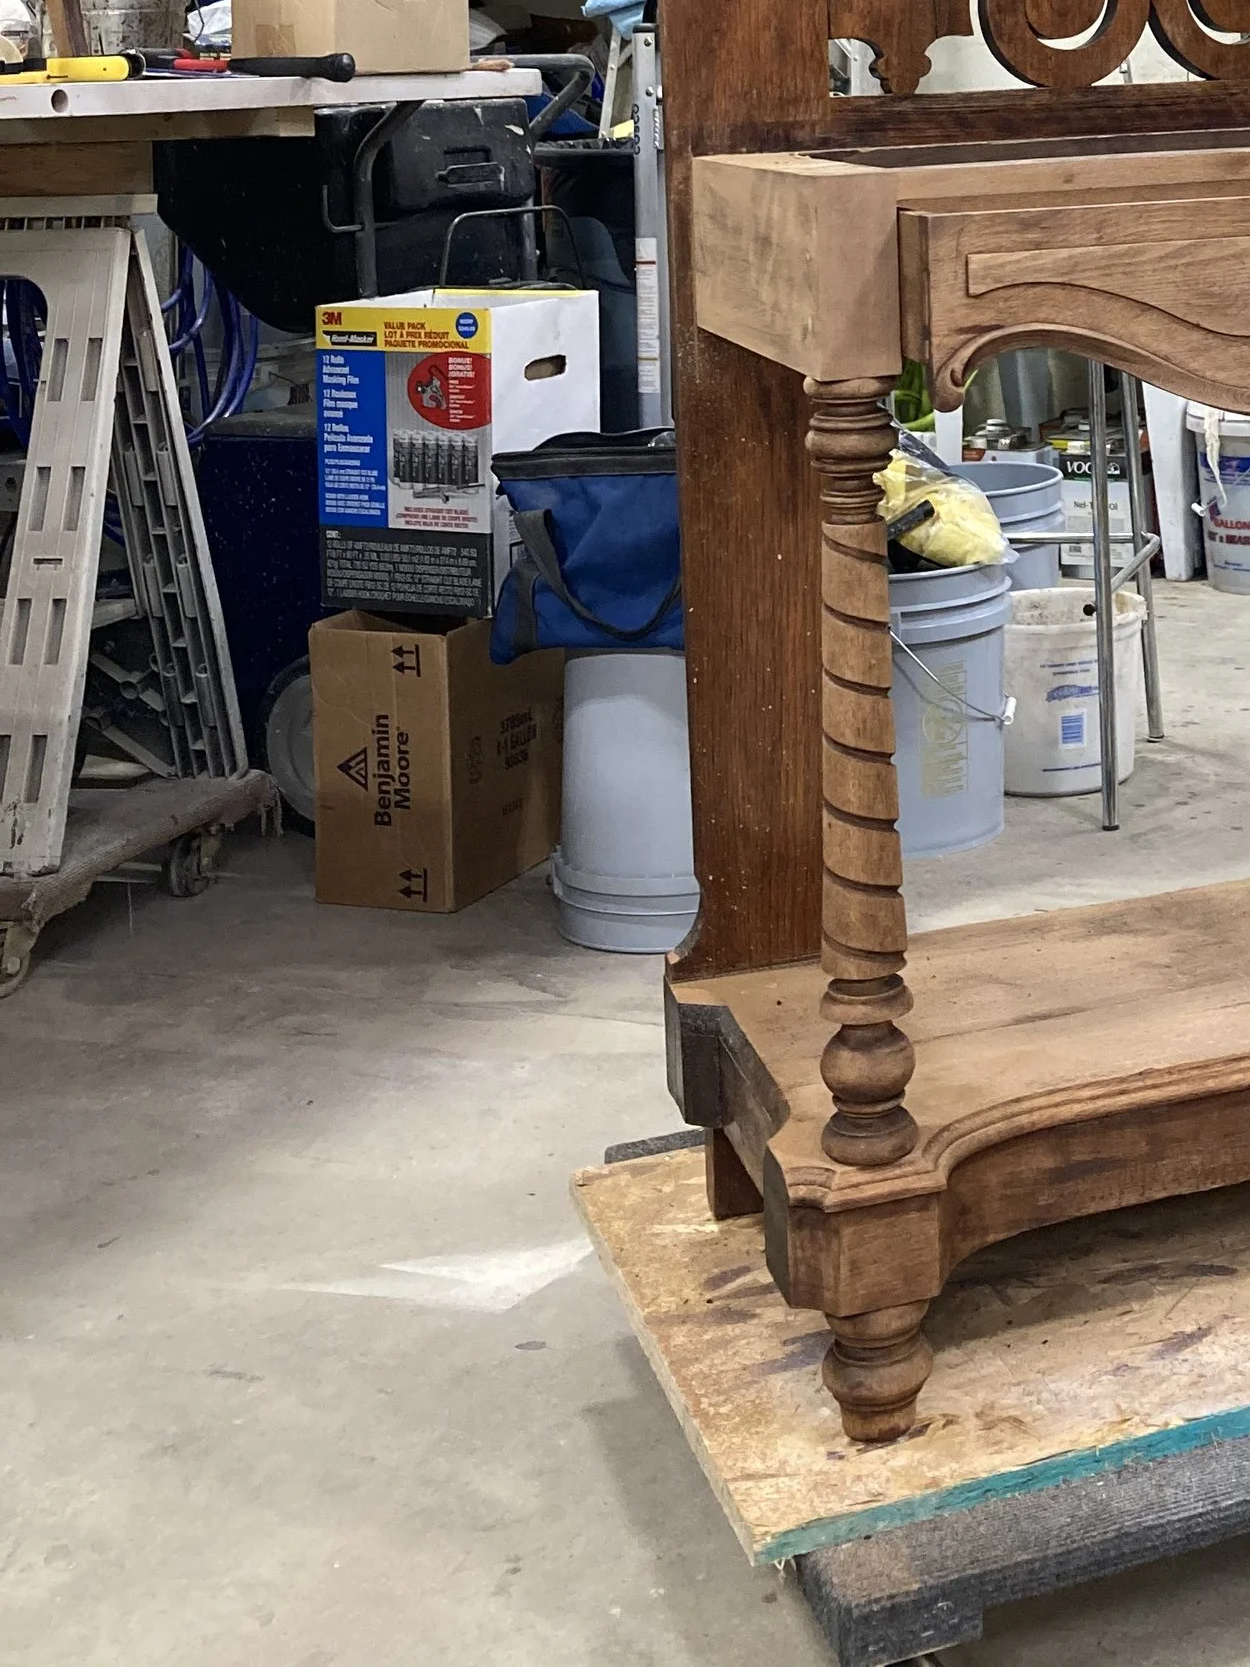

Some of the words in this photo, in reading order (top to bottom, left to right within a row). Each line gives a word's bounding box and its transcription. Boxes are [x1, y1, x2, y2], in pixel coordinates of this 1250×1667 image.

[322, 311, 342, 326] 3M
[384, 321, 405, 330] VALUE
[407, 322, 426, 331] PACK
[384, 340, 416, 349] PAQUETE
[417, 340, 470, 350] PROMOCIONAL
[1066, 460, 1093, 475] VOC
[372, 713, 396, 827] Benjamin
[393, 730, 411, 811] Moore
